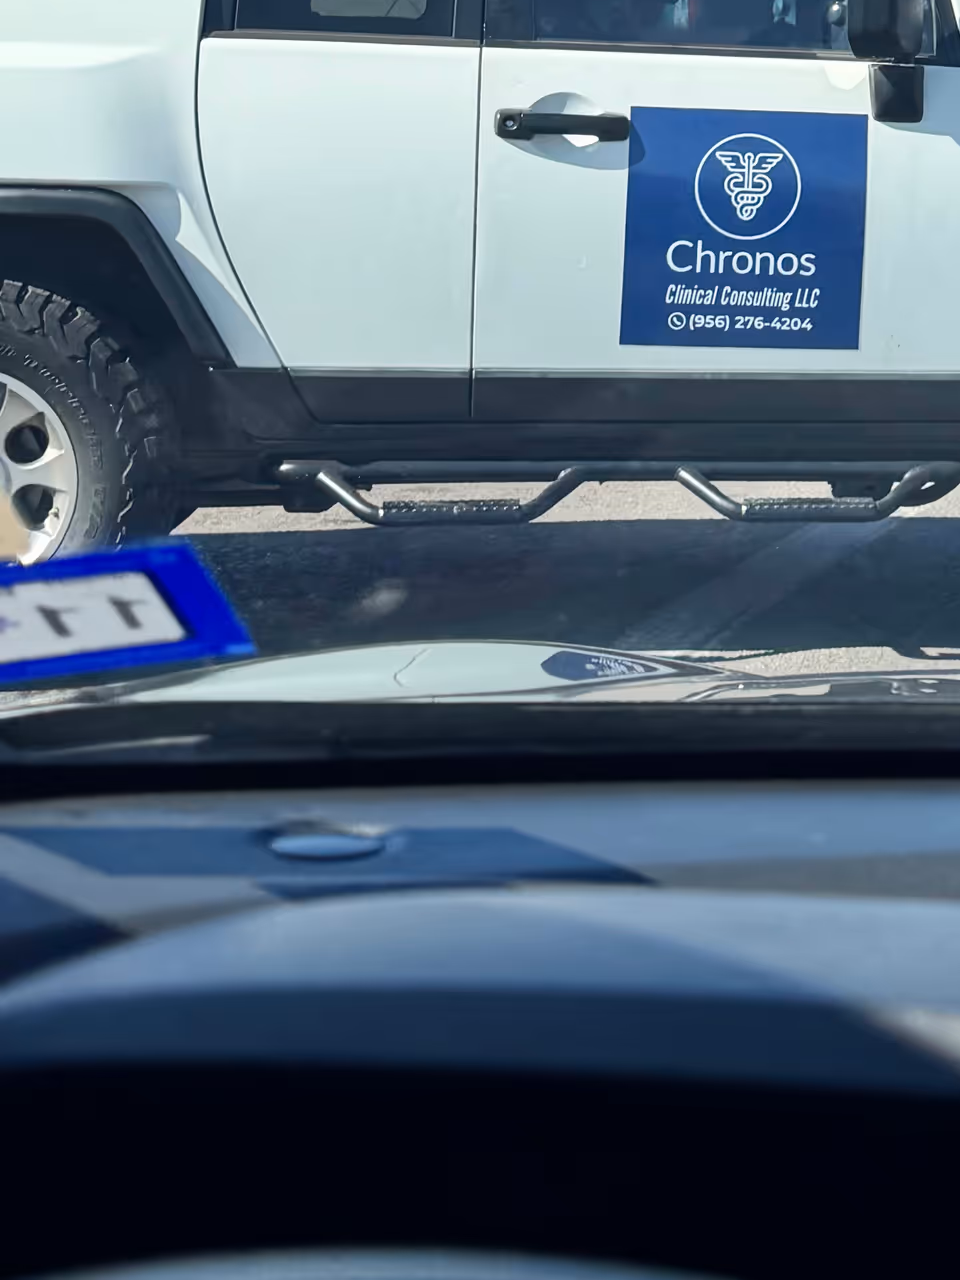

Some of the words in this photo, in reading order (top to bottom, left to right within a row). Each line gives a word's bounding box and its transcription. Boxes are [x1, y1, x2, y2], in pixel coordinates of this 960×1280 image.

[666, 239, 816, 276] Chronos
[665, 284, 719, 305] Clinical
[720, 285, 793, 311] Consulting
[794, 287, 820, 308] LLC
[689, 314, 730, 331] (956)
[734, 315, 813, 331] 276-4204
